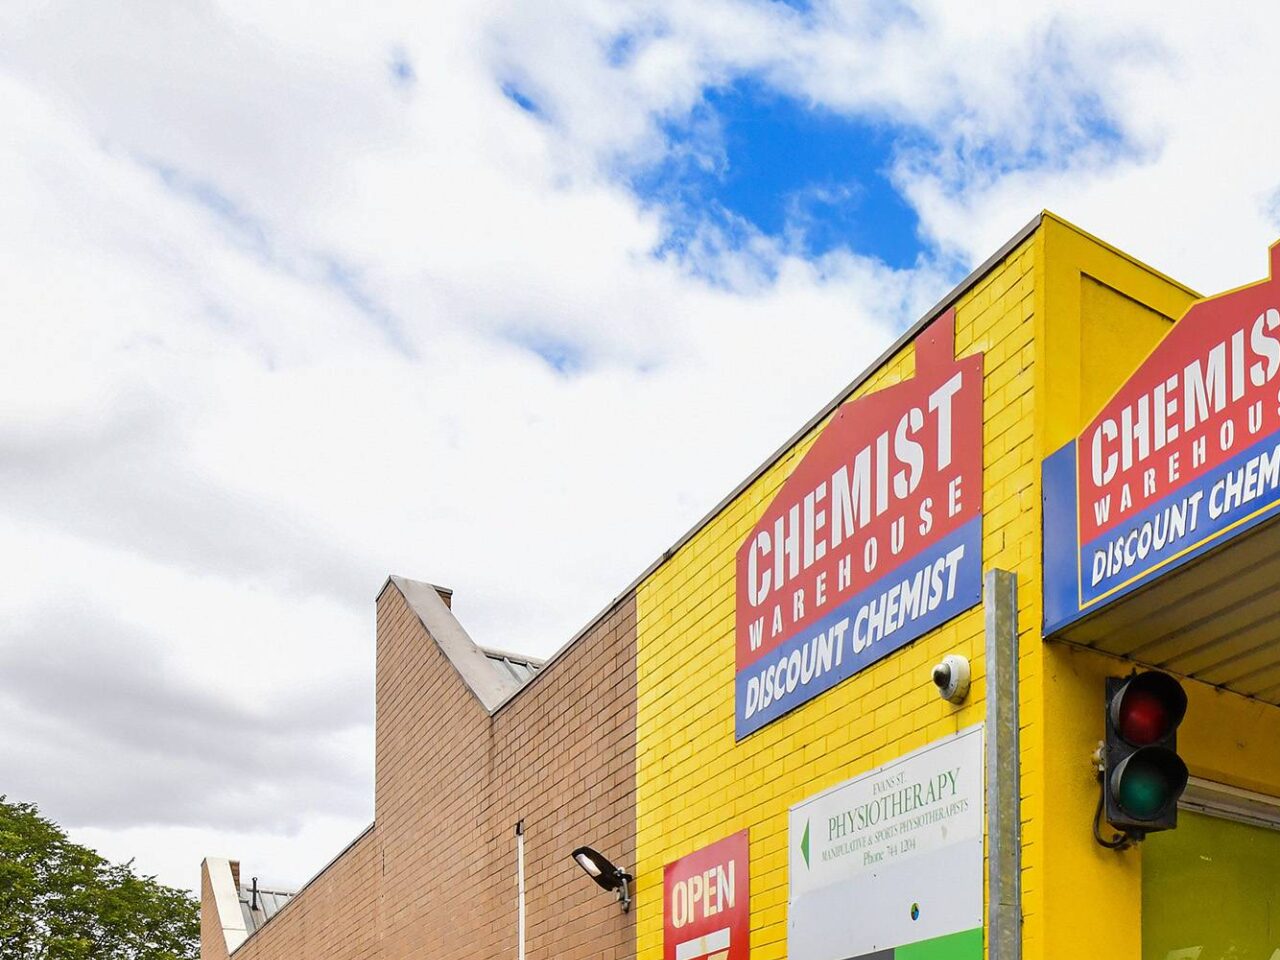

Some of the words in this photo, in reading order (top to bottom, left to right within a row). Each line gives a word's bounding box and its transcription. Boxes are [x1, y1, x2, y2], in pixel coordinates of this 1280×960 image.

[747, 373, 963, 607] CHEMIST
[748, 475, 963, 652] WAREHOUSE
[1091, 488, 1204, 588] DISCOUNT
[744, 622, 849, 720] DISCOUNT
[852, 545, 965, 653] CHEMIST
[821, 836, 866, 861] MANIPULATIVE
[874, 827, 898, 842] SPORTS
[900, 797, 969, 833] PHYSIOTHERAPISTS
[828, 767, 960, 842] PHYSIOTHERAPY
[671, 861, 736, 929] OPEN
[863, 851, 884, 866] Phone
